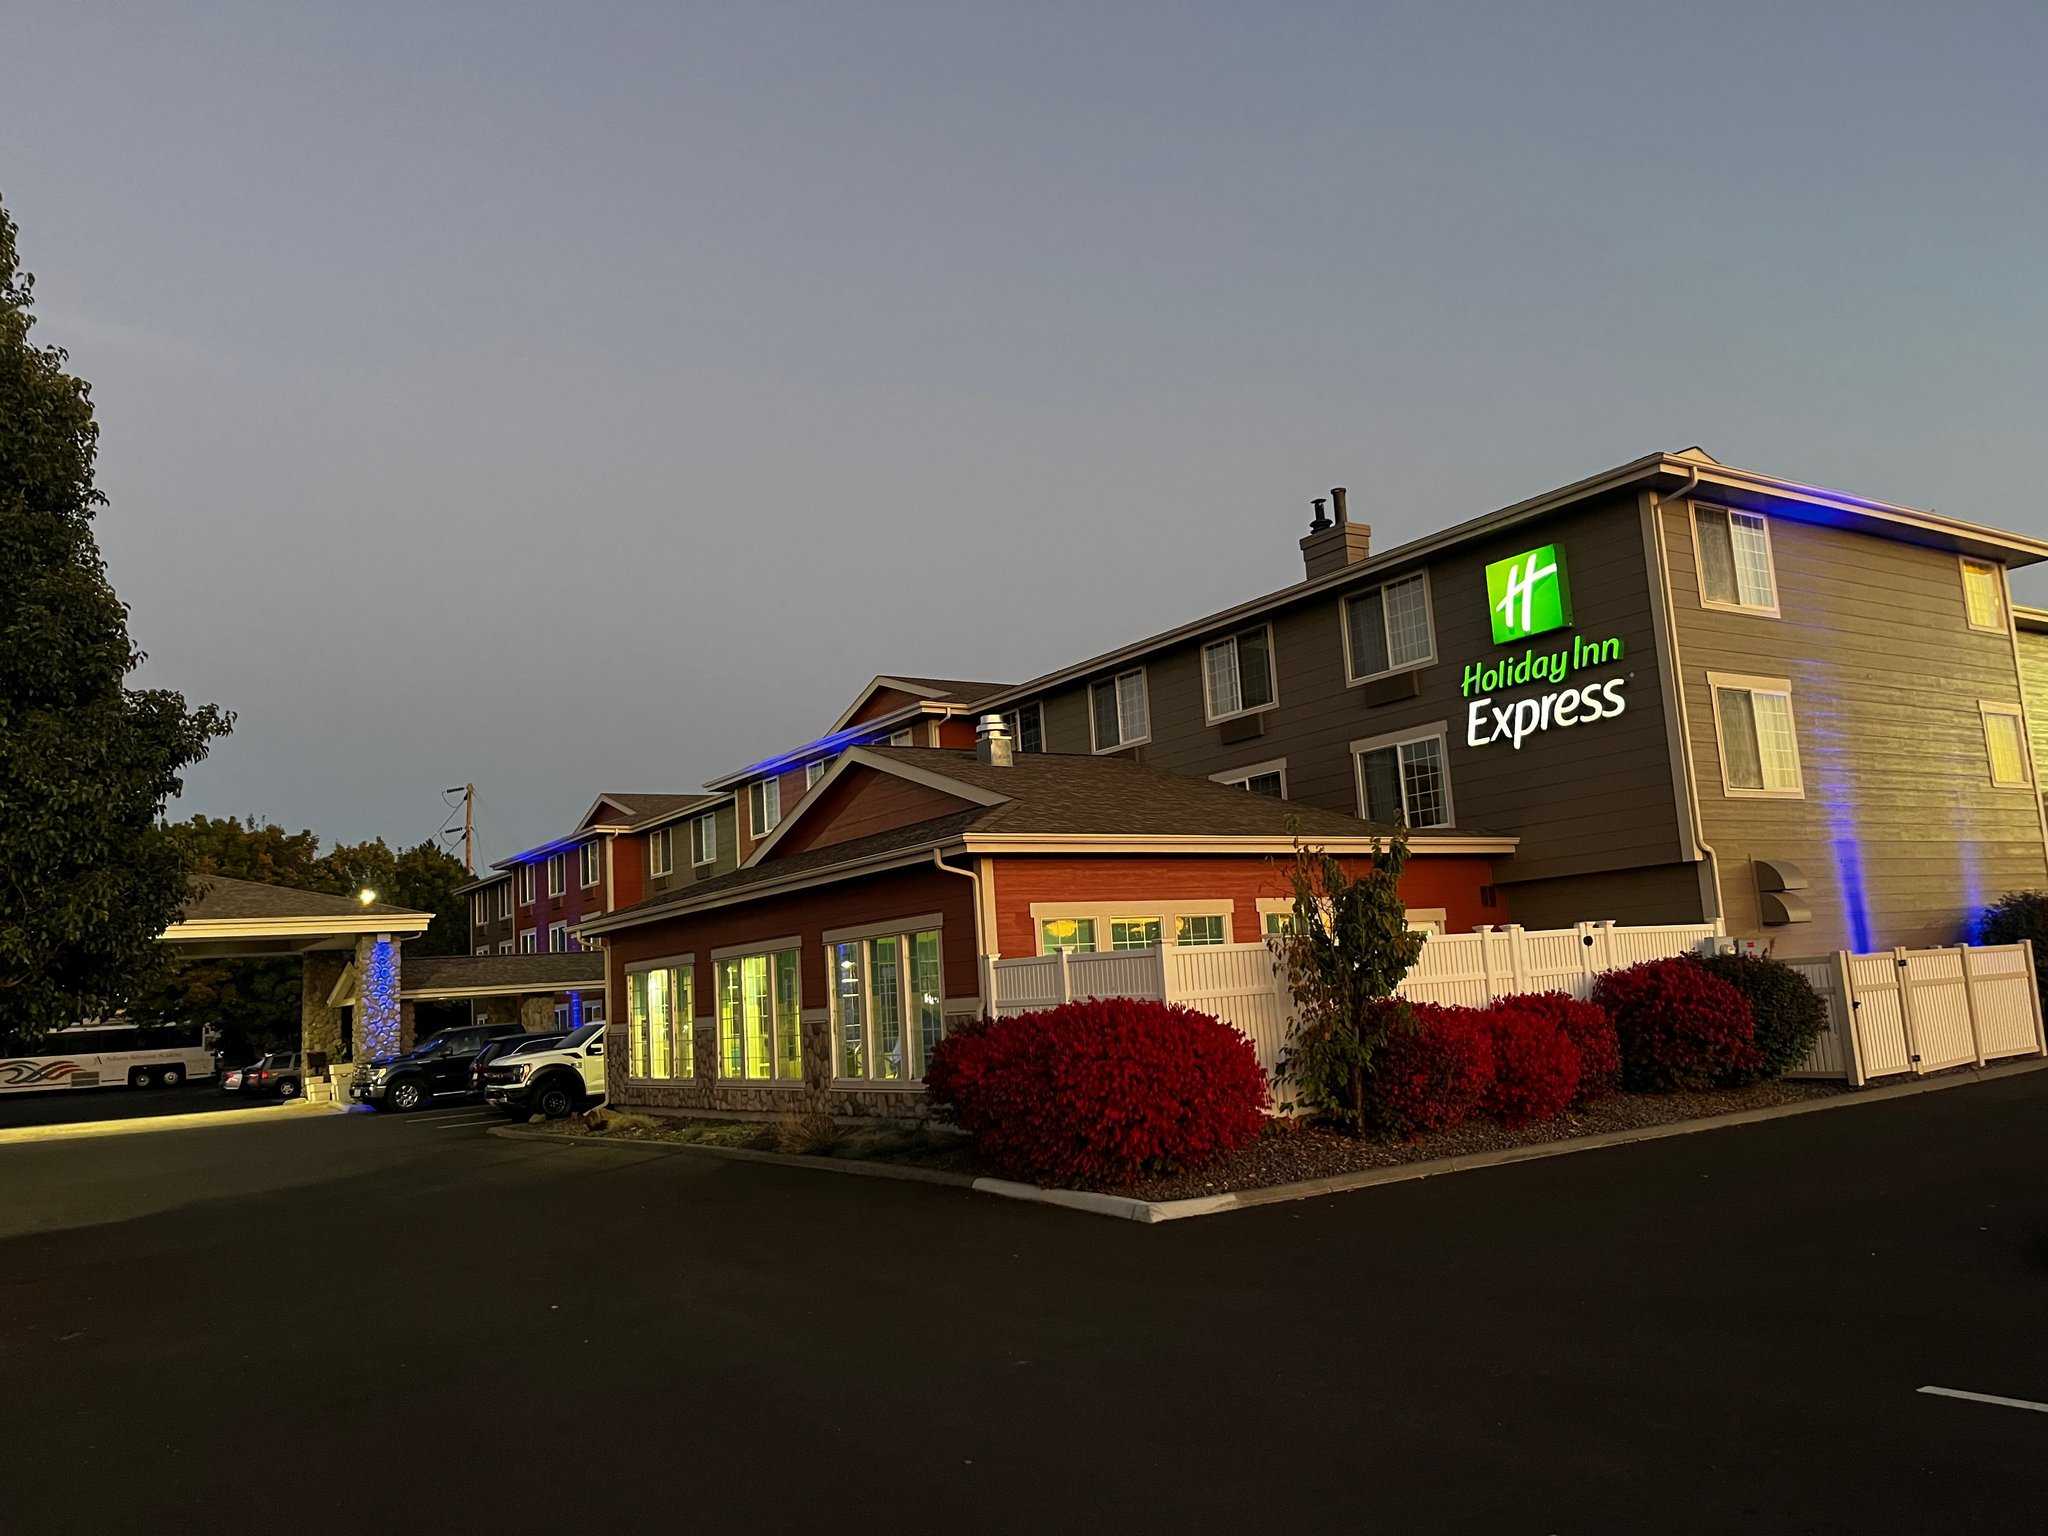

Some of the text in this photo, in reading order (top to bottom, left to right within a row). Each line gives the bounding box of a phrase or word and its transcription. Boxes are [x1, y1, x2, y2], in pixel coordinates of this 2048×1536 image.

[1461, 635, 1621, 697] Holiday Inn
[1467, 679, 1626, 750] Express
